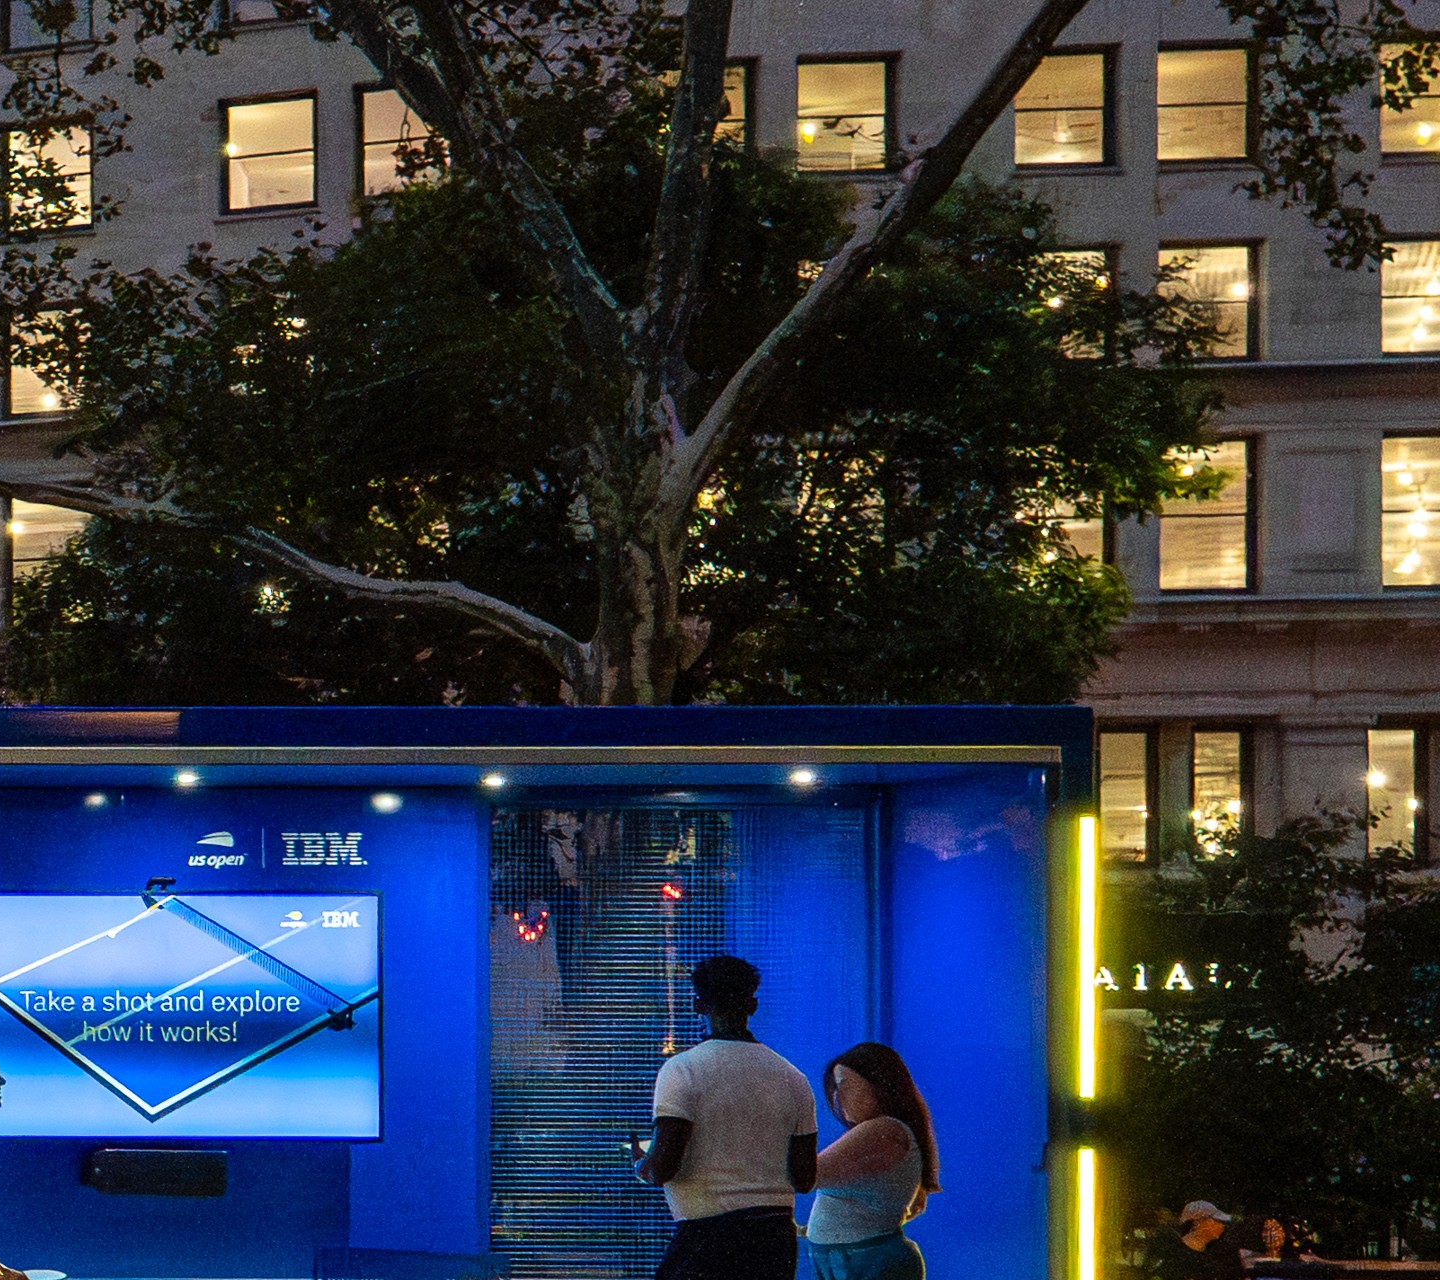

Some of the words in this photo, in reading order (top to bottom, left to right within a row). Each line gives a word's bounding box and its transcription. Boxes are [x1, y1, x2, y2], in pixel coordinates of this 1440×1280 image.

[281, 832, 368, 866] IBM
[188, 855, 206, 867] us
[207, 854, 245, 869] open
[20, 990, 75, 1012] Take
[81, 996, 96, 1012] a
[102, 990, 153, 1012] shot
[160, 990, 203, 1012] and
[211, 990, 300, 1016] explore
[83, 1020, 132, 1042] how
[138, 1020, 154, 1042] it
[160, 1020, 237, 1042] works!
